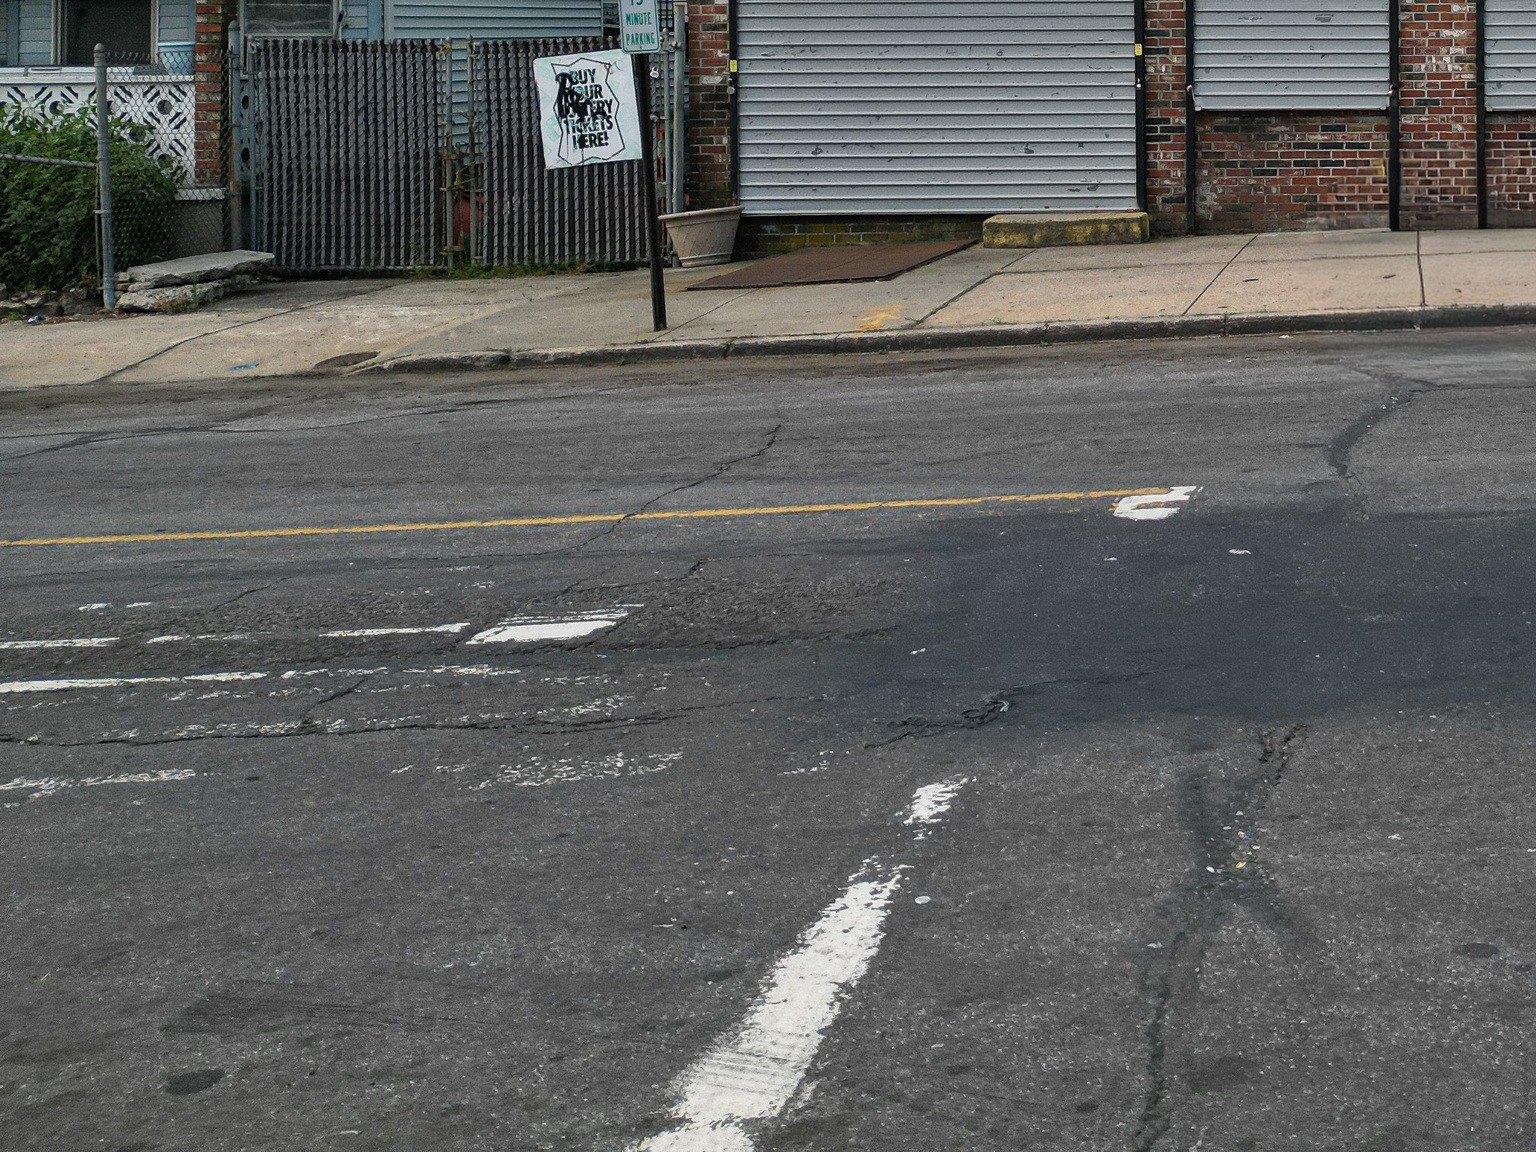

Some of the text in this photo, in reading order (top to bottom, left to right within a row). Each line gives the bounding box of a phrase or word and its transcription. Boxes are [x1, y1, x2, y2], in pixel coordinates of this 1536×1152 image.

[625, 11, 652, 26] MINUTE
[626, 32, 656, 46] PARKING
[572, 131, 609, 149] HERE!
